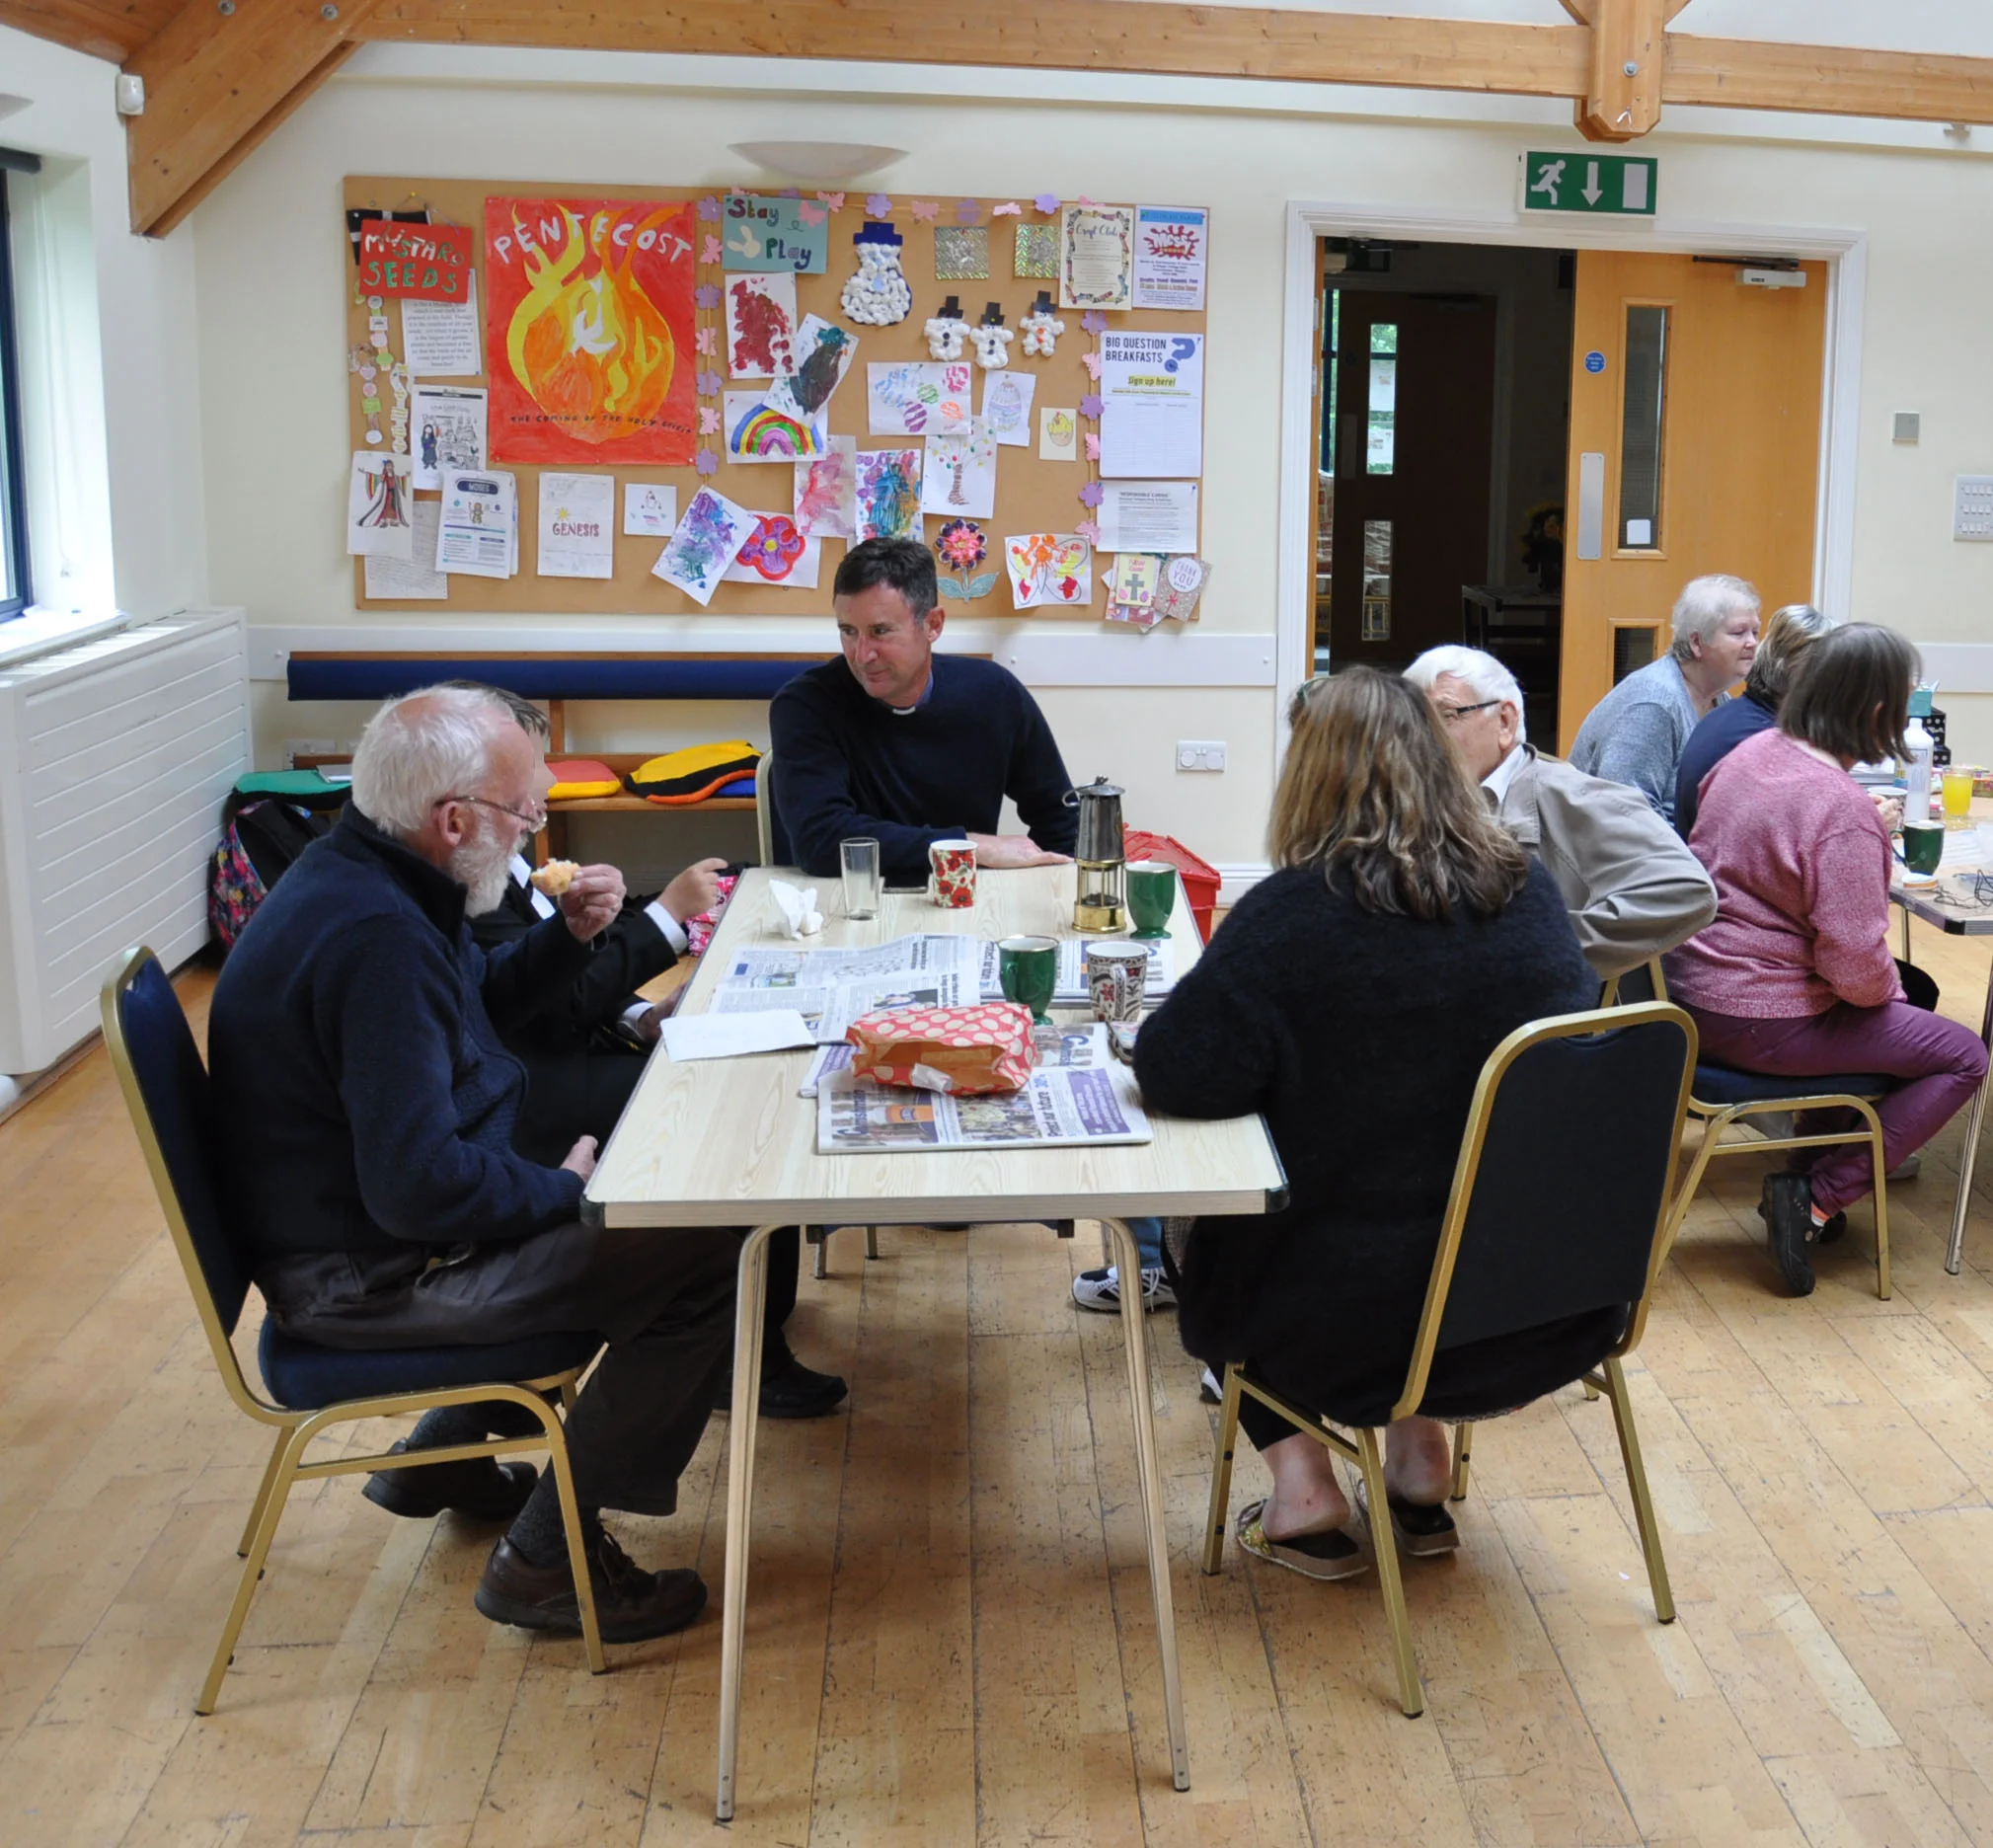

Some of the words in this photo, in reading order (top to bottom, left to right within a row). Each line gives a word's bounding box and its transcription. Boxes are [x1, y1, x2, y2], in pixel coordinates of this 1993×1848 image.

[728, 198, 780, 227] Stay
[494, 213, 692, 265] PENTECOST
[363, 261, 457, 293] SEEDS
[1105, 337, 1120, 348] BIG
[1122, 338, 1167, 349] QUESTION
[1105, 350, 1163, 363] BREAKFASTS
[1127, 376, 1143, 387] Sign
[1144, 378, 1155, 387] up
[1155, 376, 1176, 387] here!
[553, 522, 599, 537] GENESIS
[1174, 569, 1193, 586] YOU
